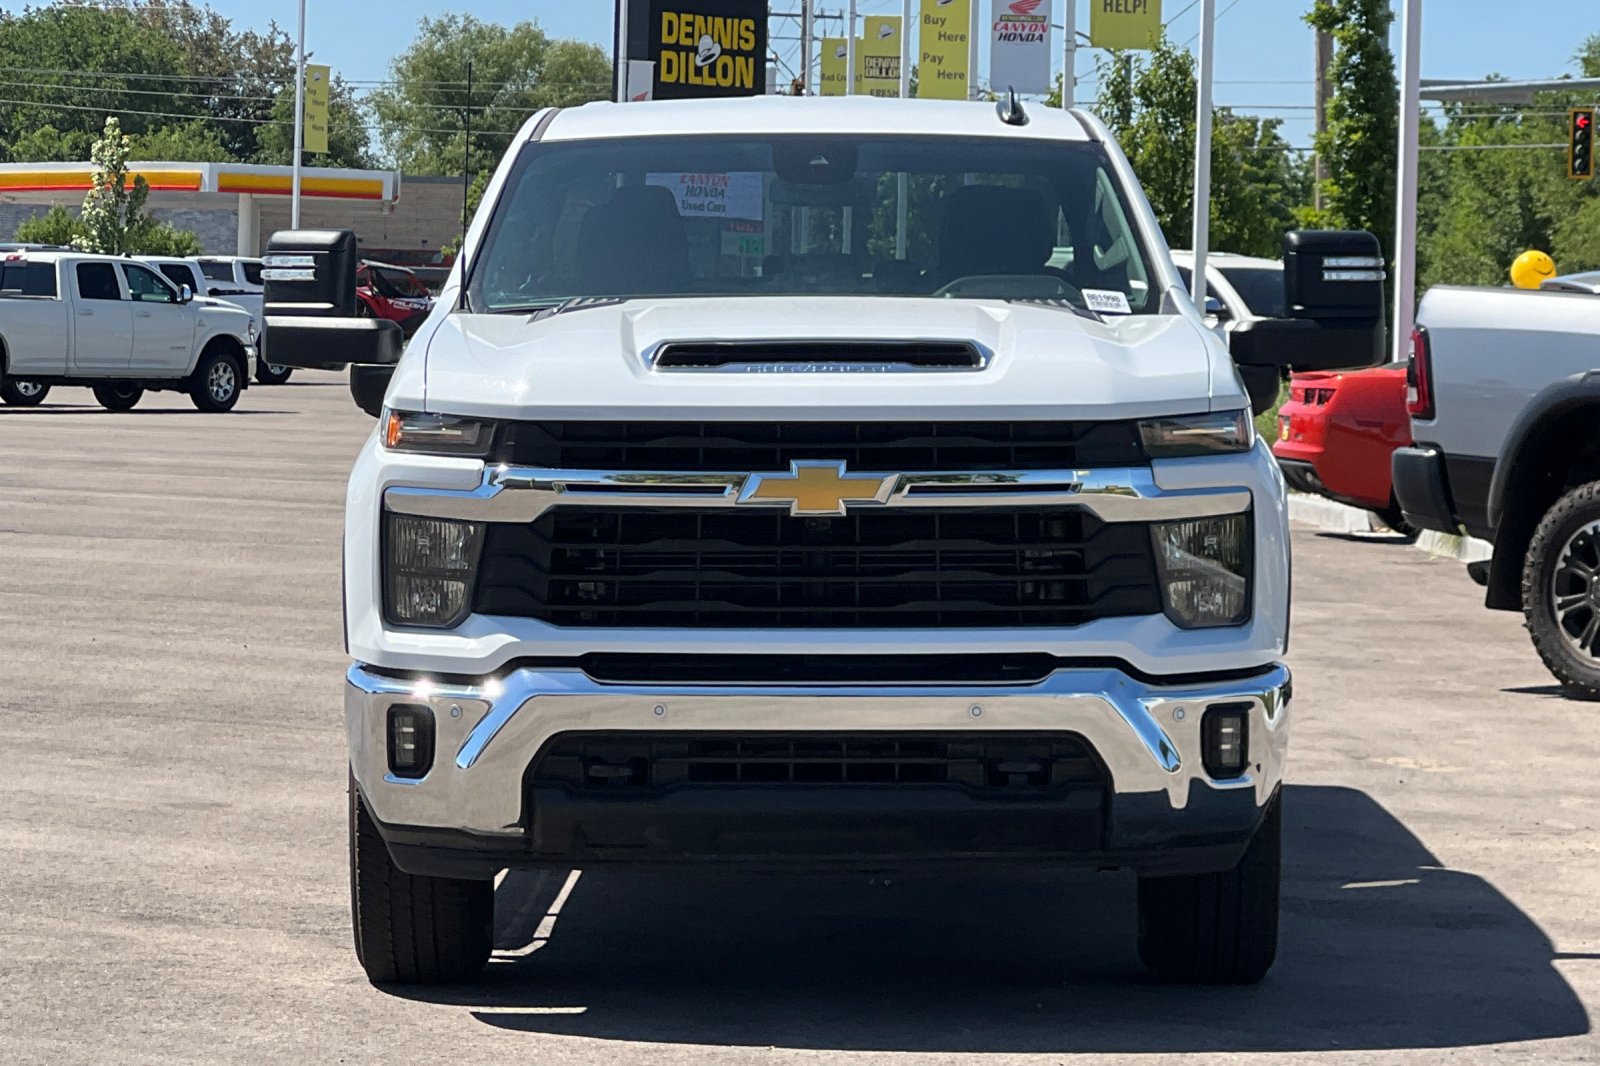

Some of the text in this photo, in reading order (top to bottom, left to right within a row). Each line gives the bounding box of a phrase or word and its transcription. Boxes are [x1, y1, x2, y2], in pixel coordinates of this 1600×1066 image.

[1103, 0, 1147, 14] HELP!
[923, 14, 947, 28] Buy
[661, 11, 756, 51] DENNIS
[993, 22, 1049, 33] CANYON
[938, 31, 967, 42] Here
[998, 32, 1044, 43] HONDA
[923, 52, 944, 66] Pay
[660, 50, 755, 89] DILLON
[937, 69, 965, 80] Here
[686, 185, 725, 197] HONDA
[682, 200, 727, 212] Used Cars
